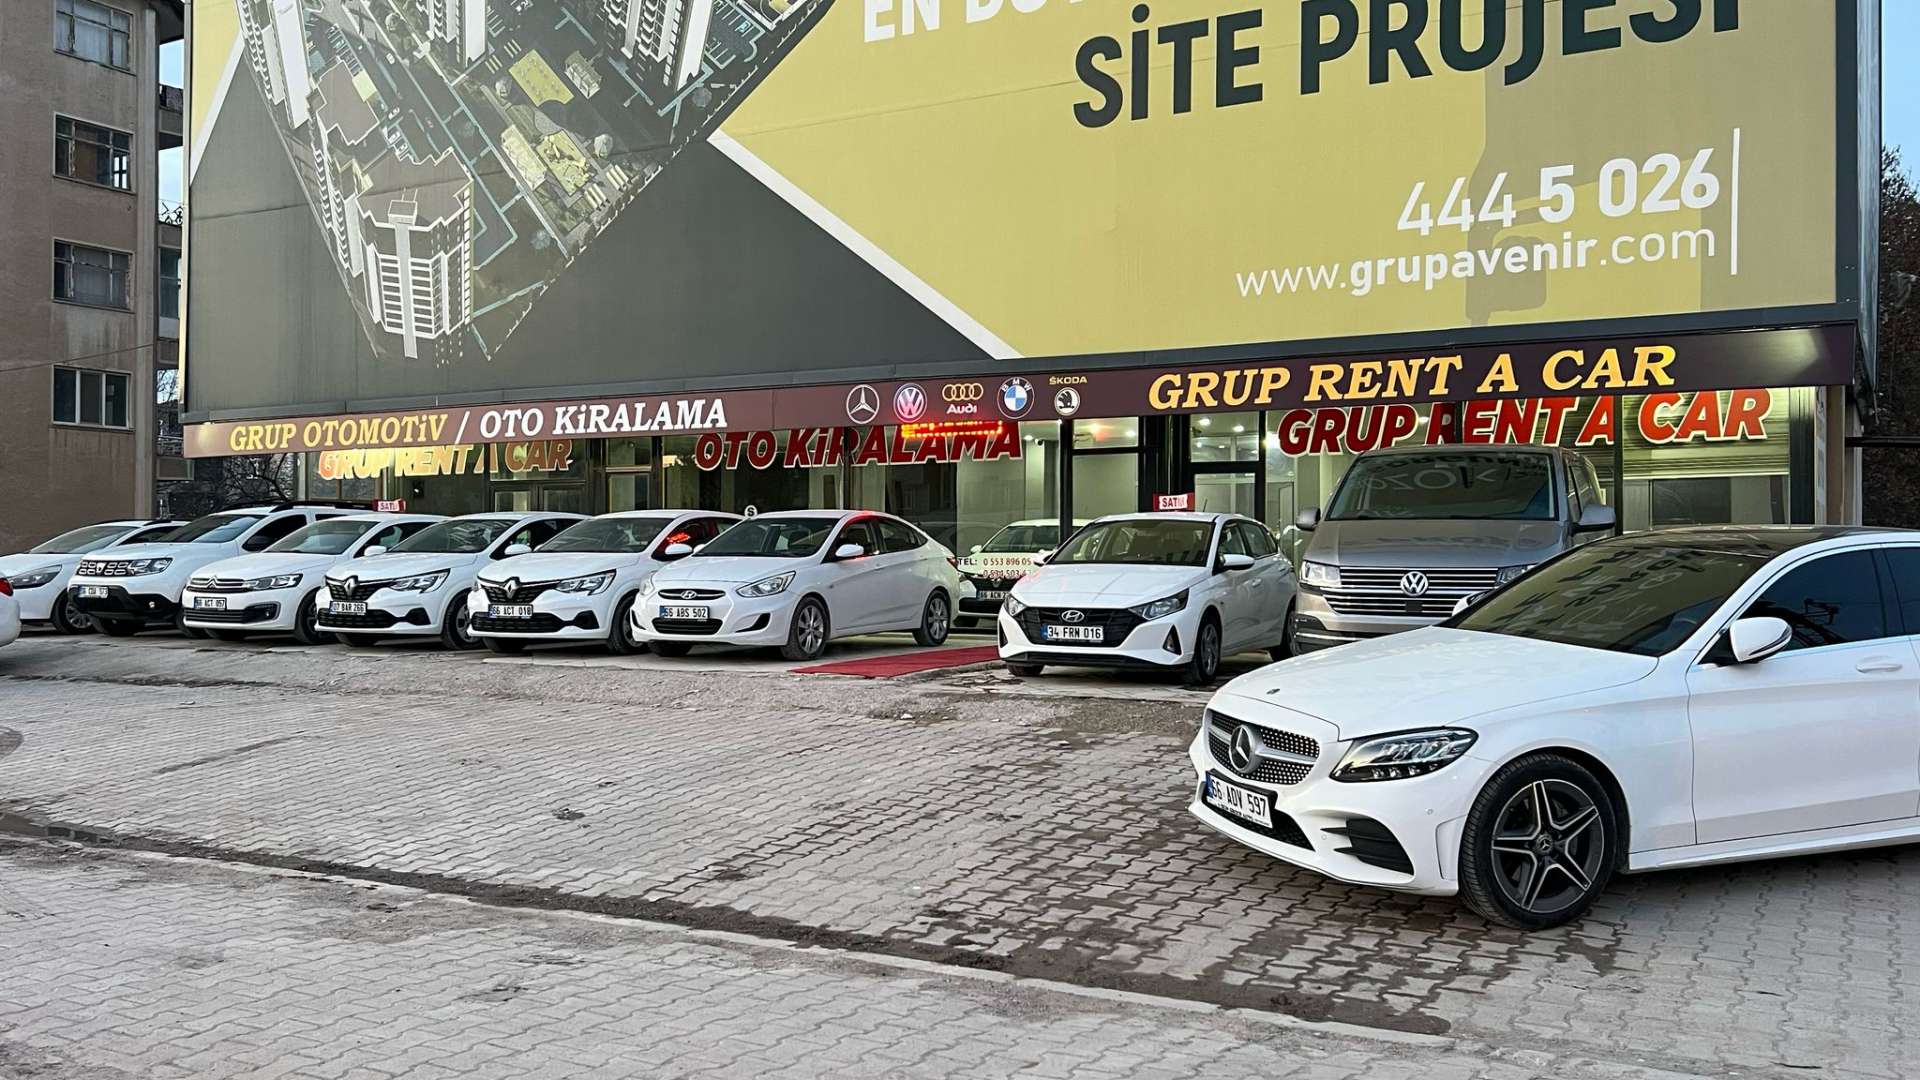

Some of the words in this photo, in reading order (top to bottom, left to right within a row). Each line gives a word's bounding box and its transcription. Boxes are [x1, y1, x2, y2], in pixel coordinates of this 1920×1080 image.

[1397, 172, 1516, 236] 444
[1539, 164, 1575, 224] 5
[1599, 148, 1720, 217] 026
[1235, 229, 1716, 297] www.grupavenir.com
[1149, 367, 1291, 410] GRUP
[1303, 355, 1463, 401] RENT
[1476, 353, 1519, 393] A
[1542, 345, 1676, 391] CAR
[946, 403, 978, 414] Audi
[1277, 402, 1417, 456] GRUP
[1425, 397, 1580, 445] RENT
[1576, 394, 1614, 446] A
[1638, 388, 1773, 444] CAR
[229, 422, 297, 451] GRUP
[480, 407, 544, 439] OTO
[395, 443, 474, 477] RENT
[504, 439, 573, 474] CAR
[695, 432, 778, 471] OTO
[676, 608, 690, 617] ABS
[693, 608, 706, 618] 502
[1048, 626, 1059, 637] 34
[1063, 627, 1080, 638] FRN
[1084, 628, 1101, 639] 016
[1247, 793, 1267, 817] 597
